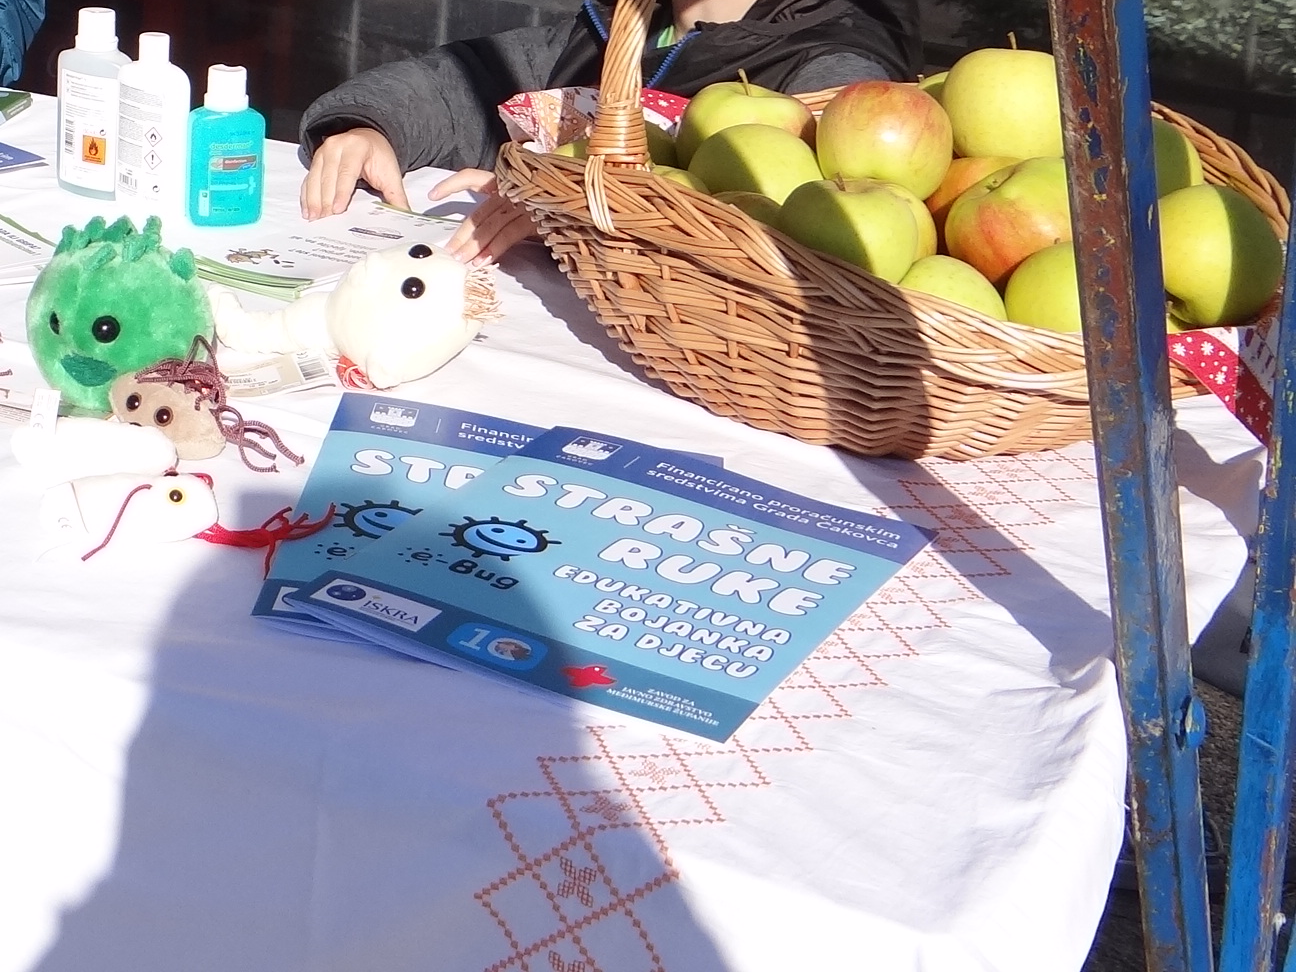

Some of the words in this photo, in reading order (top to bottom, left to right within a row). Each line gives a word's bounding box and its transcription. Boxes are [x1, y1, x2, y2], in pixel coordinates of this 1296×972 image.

[502, 473, 858, 586] STRAŠNE
[646, 469, 747, 505] sredstvima
[753, 502, 810, 525] Grada
[816, 520, 898, 549] Čakovca
[656, 462, 764, 503] Financirano
[770, 497, 901, 540] proračunskim
[411, 549, 519, 590] e-Bug
[553, 564, 792, 645] EDUKATIVNA
[598, 537, 824, 616] RUKE
[363, 595, 420, 625] ISKRA
[573, 614, 629, 640] ZA
[634, 632, 759, 679] DJECU
[593, 598, 775, 662] BOJANKA
